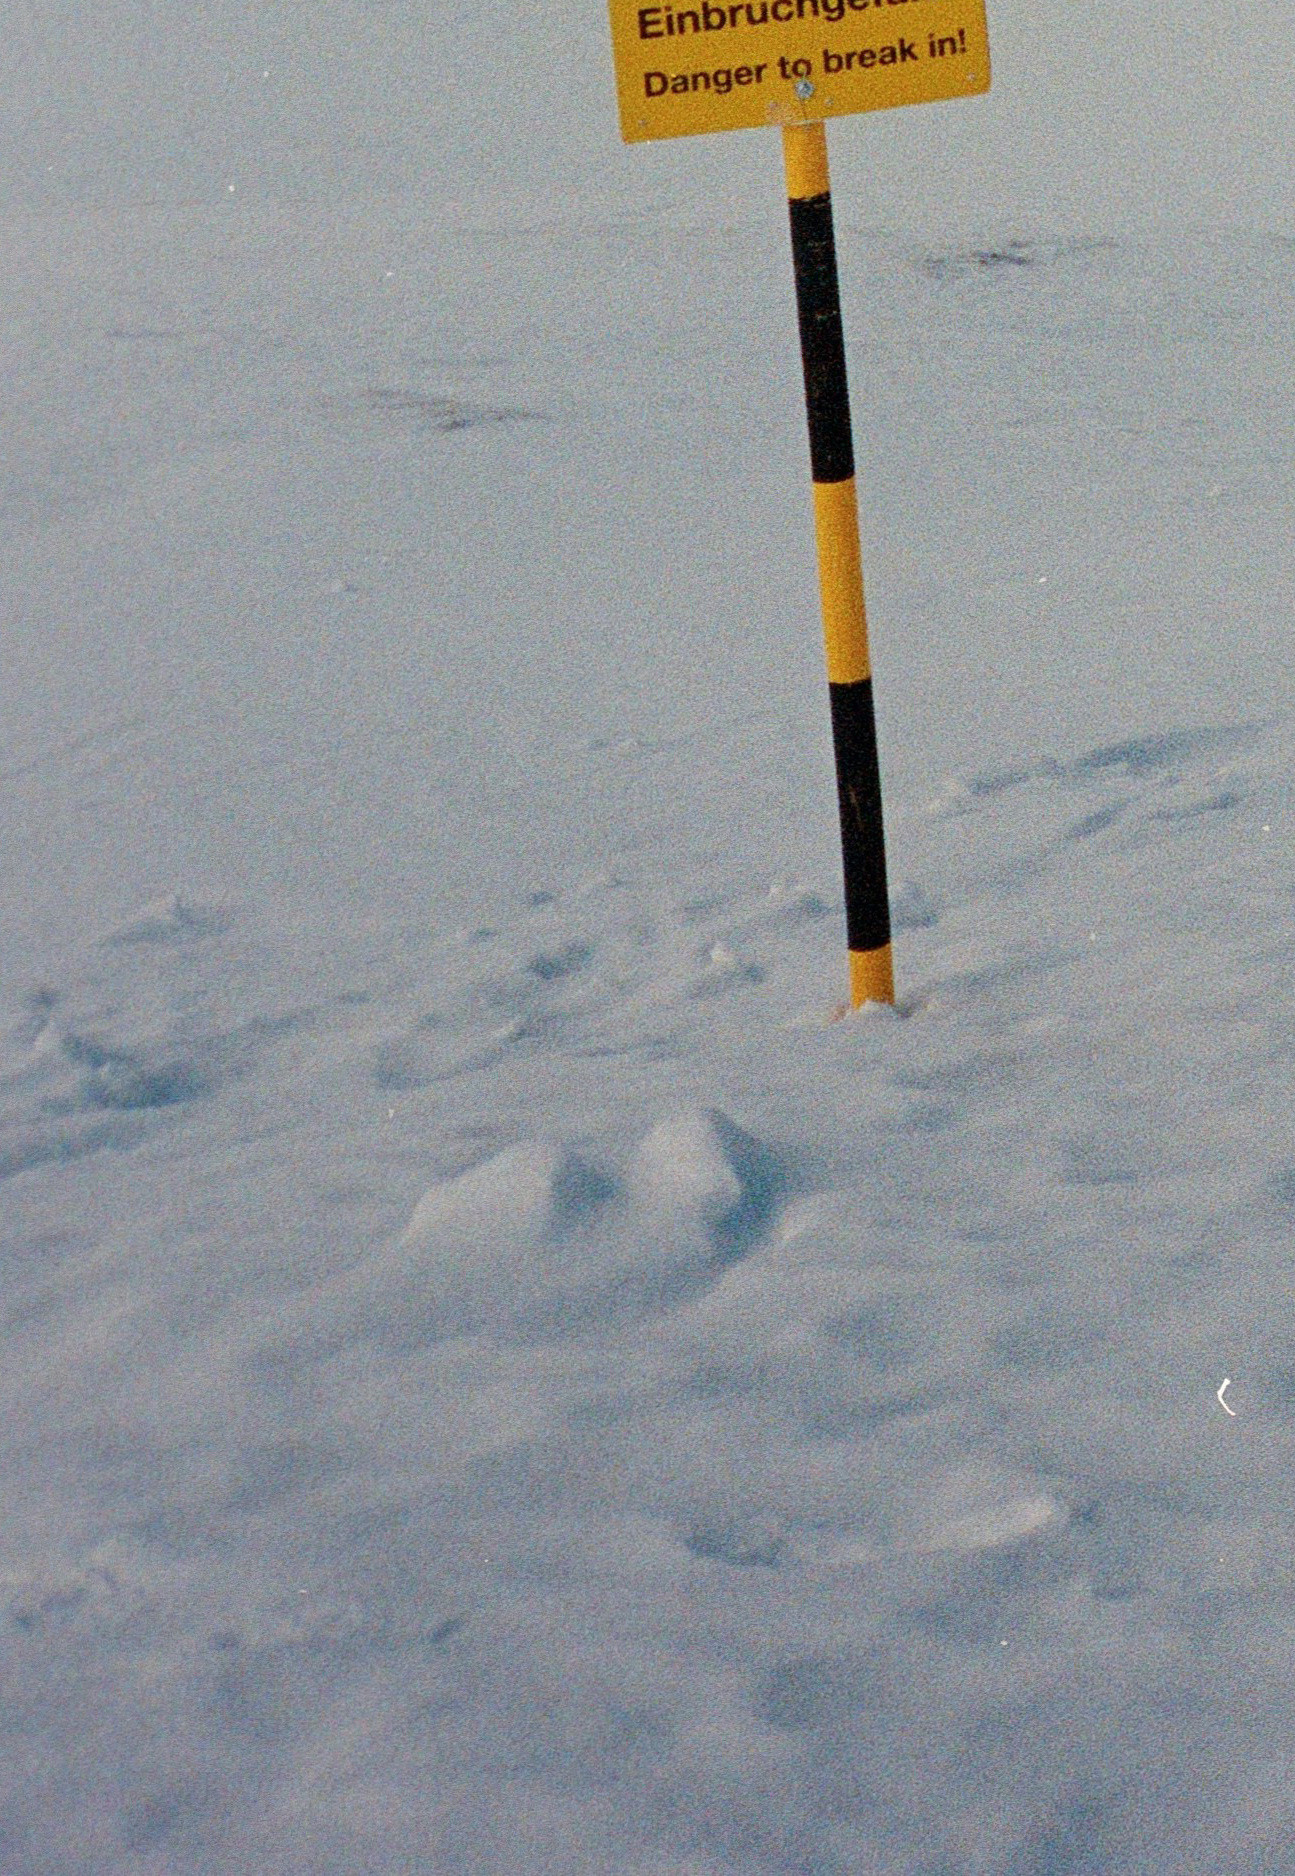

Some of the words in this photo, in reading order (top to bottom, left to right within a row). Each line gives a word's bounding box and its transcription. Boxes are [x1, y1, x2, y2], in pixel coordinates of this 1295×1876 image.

[643, 61, 768, 98] Danger
[779, 55, 813, 80] to
[822, 38, 918, 74] break
[928, 28, 968, 58] in!
